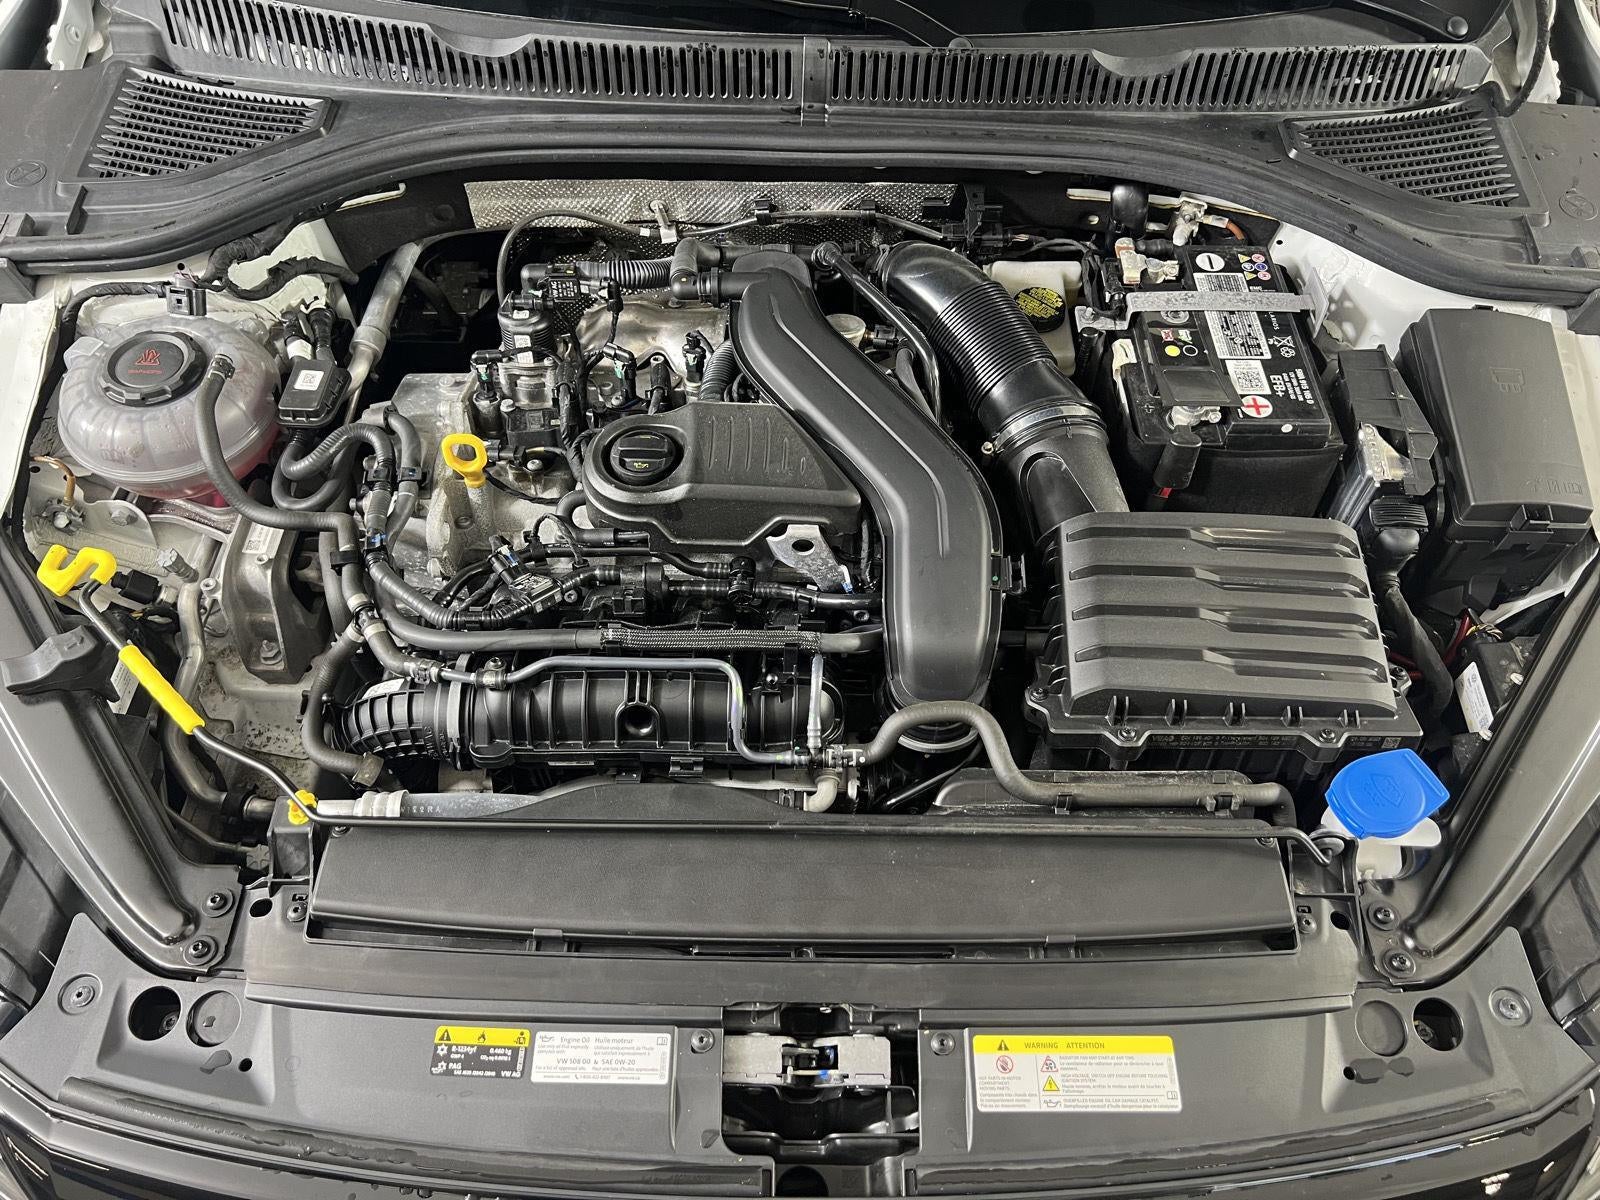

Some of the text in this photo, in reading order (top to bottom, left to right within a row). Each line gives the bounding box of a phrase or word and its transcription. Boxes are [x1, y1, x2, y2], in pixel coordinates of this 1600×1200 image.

[1269, 312, 1280, 330] LARIOS
[1270, 374, 1286, 397] EFB+
[1300, 380, 1309, 390] 915
